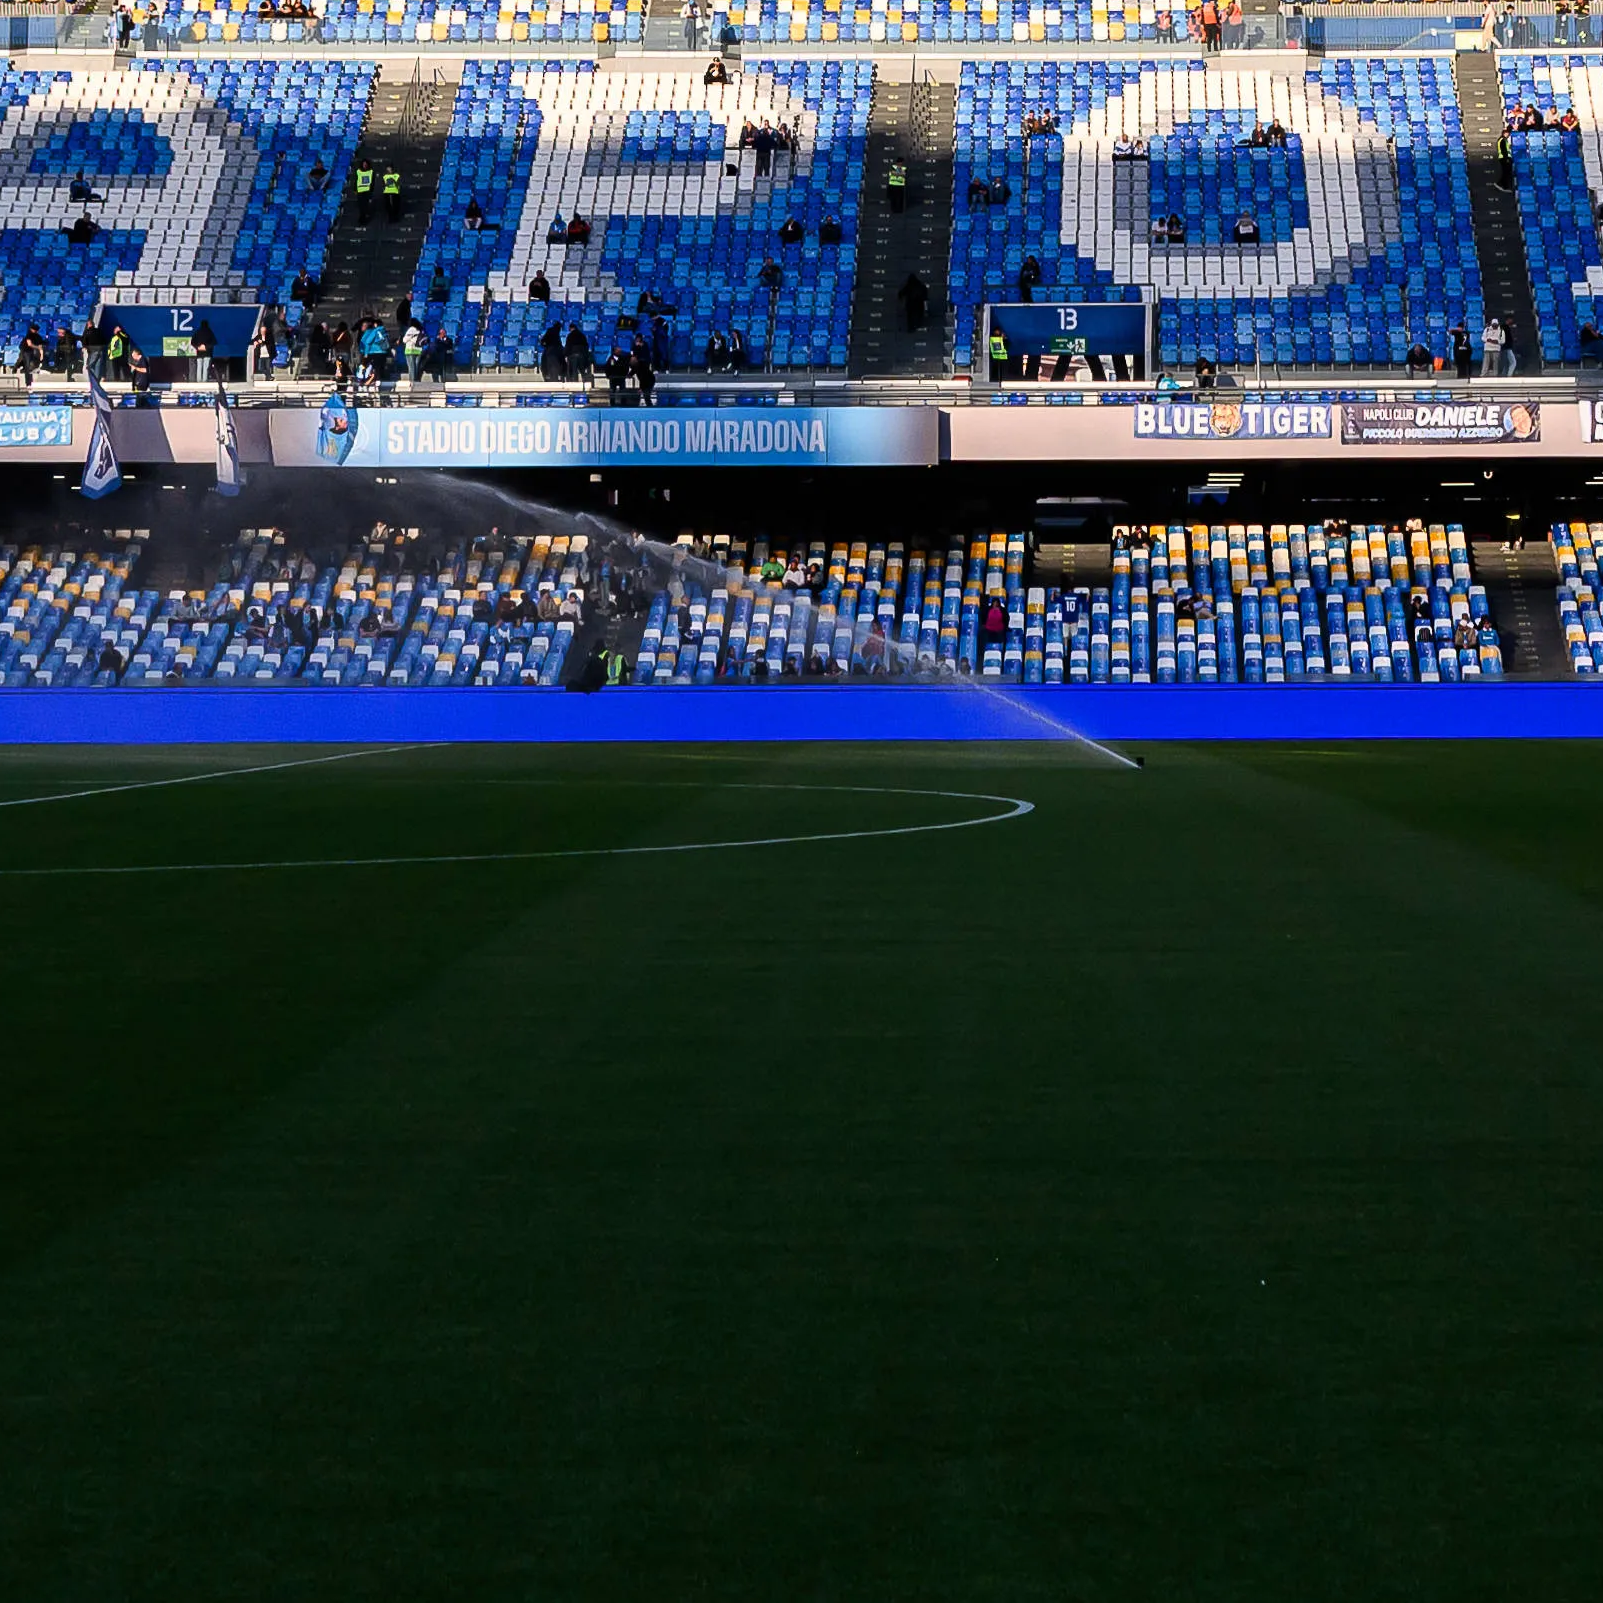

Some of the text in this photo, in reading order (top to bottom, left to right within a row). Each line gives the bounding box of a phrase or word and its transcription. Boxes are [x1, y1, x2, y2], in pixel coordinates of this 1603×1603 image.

[170, 309, 194, 332] 12
[1057, 308, 1078, 331] 13
[1136, 404, 1210, 435] BLUE
[1242, 404, 1330, 435] TIGER
[1363, 408, 1392, 421] NAPOLI
[1393, 408, 1415, 421] CLUB
[1415, 405, 1501, 427] DANIELE
[387, 420, 826, 454] STADIO DIEGO ARMANDO MARADONA
[1066, 600, 1076, 613] 10
